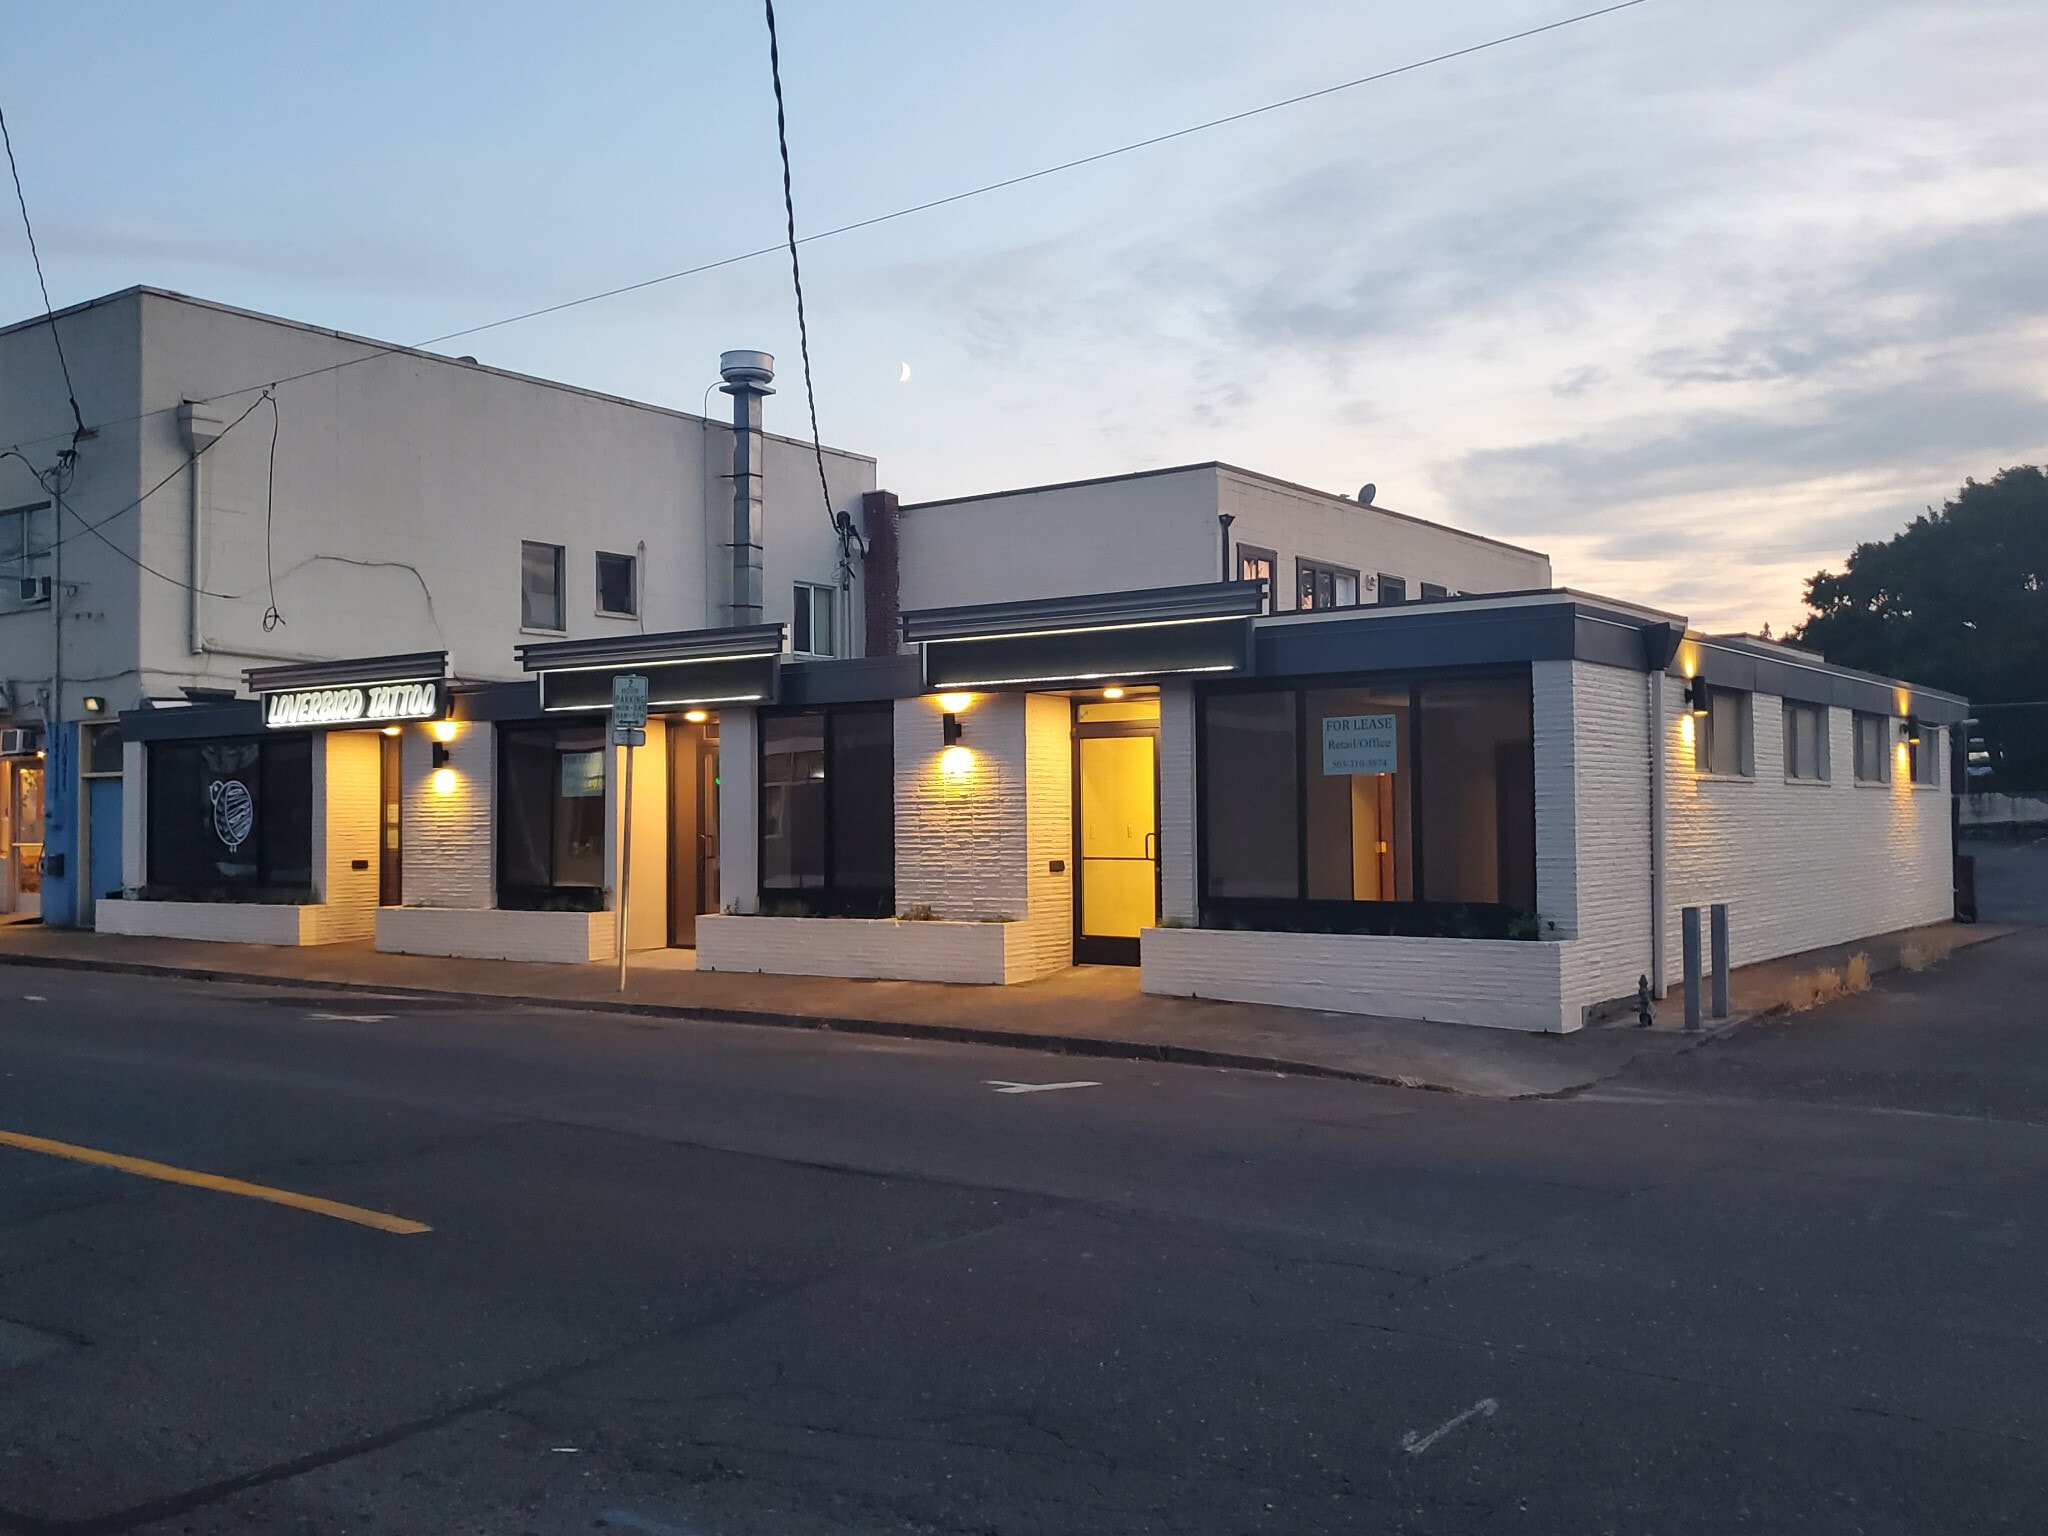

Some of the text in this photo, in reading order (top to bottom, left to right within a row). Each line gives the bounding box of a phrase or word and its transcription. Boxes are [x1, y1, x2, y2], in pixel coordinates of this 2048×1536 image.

[628, 679, 634, 688] 2
[267, 682, 437, 724] LOVERBIRD TATTOO
[615, 695, 645, 704] PARKING
[1326, 717, 1393, 732] FOR LEASE
